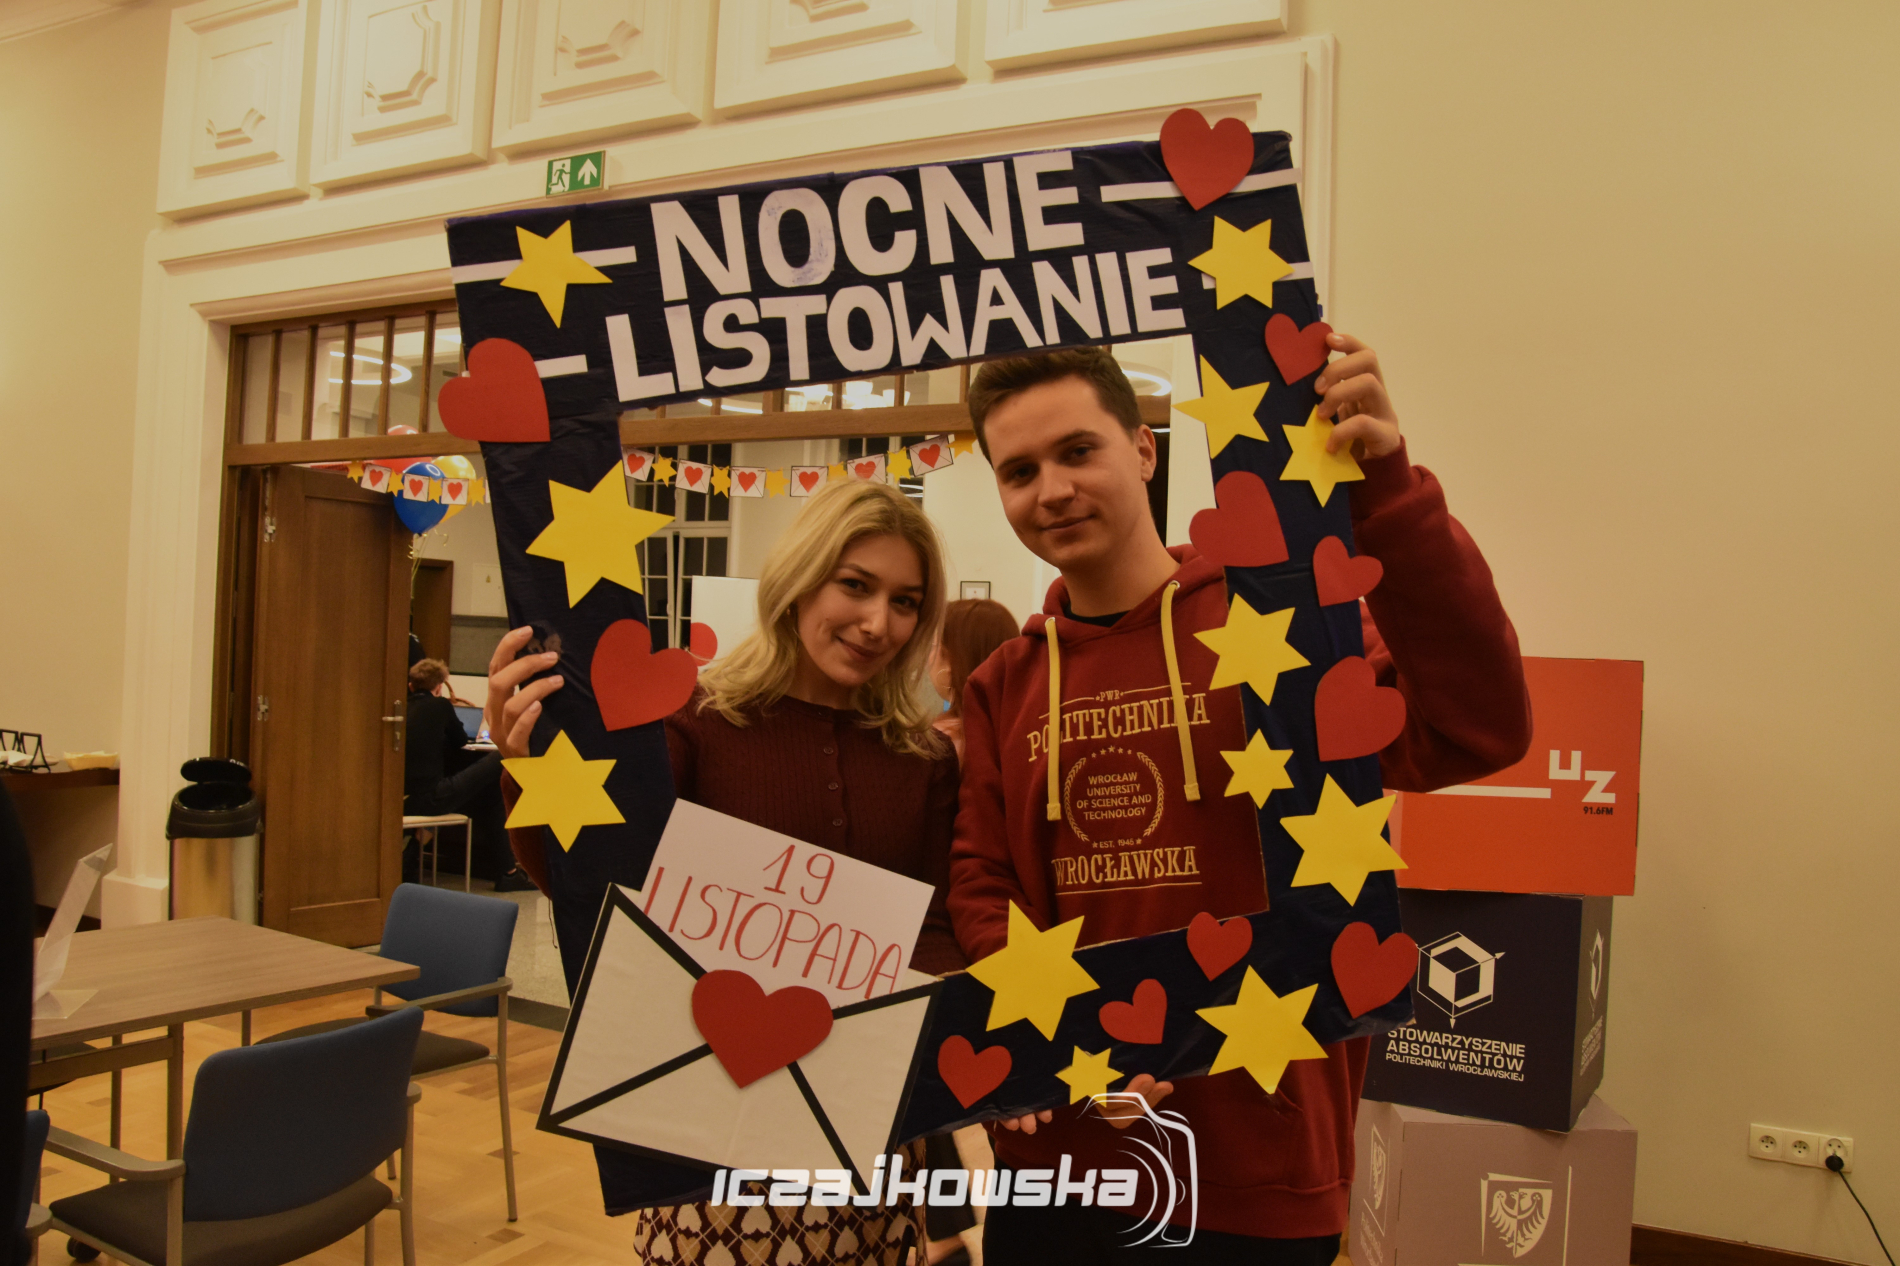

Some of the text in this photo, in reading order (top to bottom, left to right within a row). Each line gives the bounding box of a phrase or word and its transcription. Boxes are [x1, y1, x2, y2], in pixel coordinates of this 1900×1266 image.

[649, 150, 1084, 302] NOCNE
[605, 247, 1186, 402] LISTOWANIE
[1100, 689, 1120, 702] PWR
[1088, 772, 1138, 785] WROCŁAW
[1086, 783, 1141, 796] UNIVERSITY
[1076, 794, 1152, 809] OF SCIENCE AND
[1083, 806, 1146, 820] TECHNOLOGY
[1583, 806, 1613, 815] 91.6FM
[1118, 837, 1135, 847] 1945
[1051, 846, 1200, 886] WROCŁAWSKA
[763, 844, 835, 905] 19
[1387, 1039, 1525, 1072] ABSOLWENTÓW
[1385, 1052, 1525, 1082] POLITECHNIKI WROCŁAWSKIEJ
